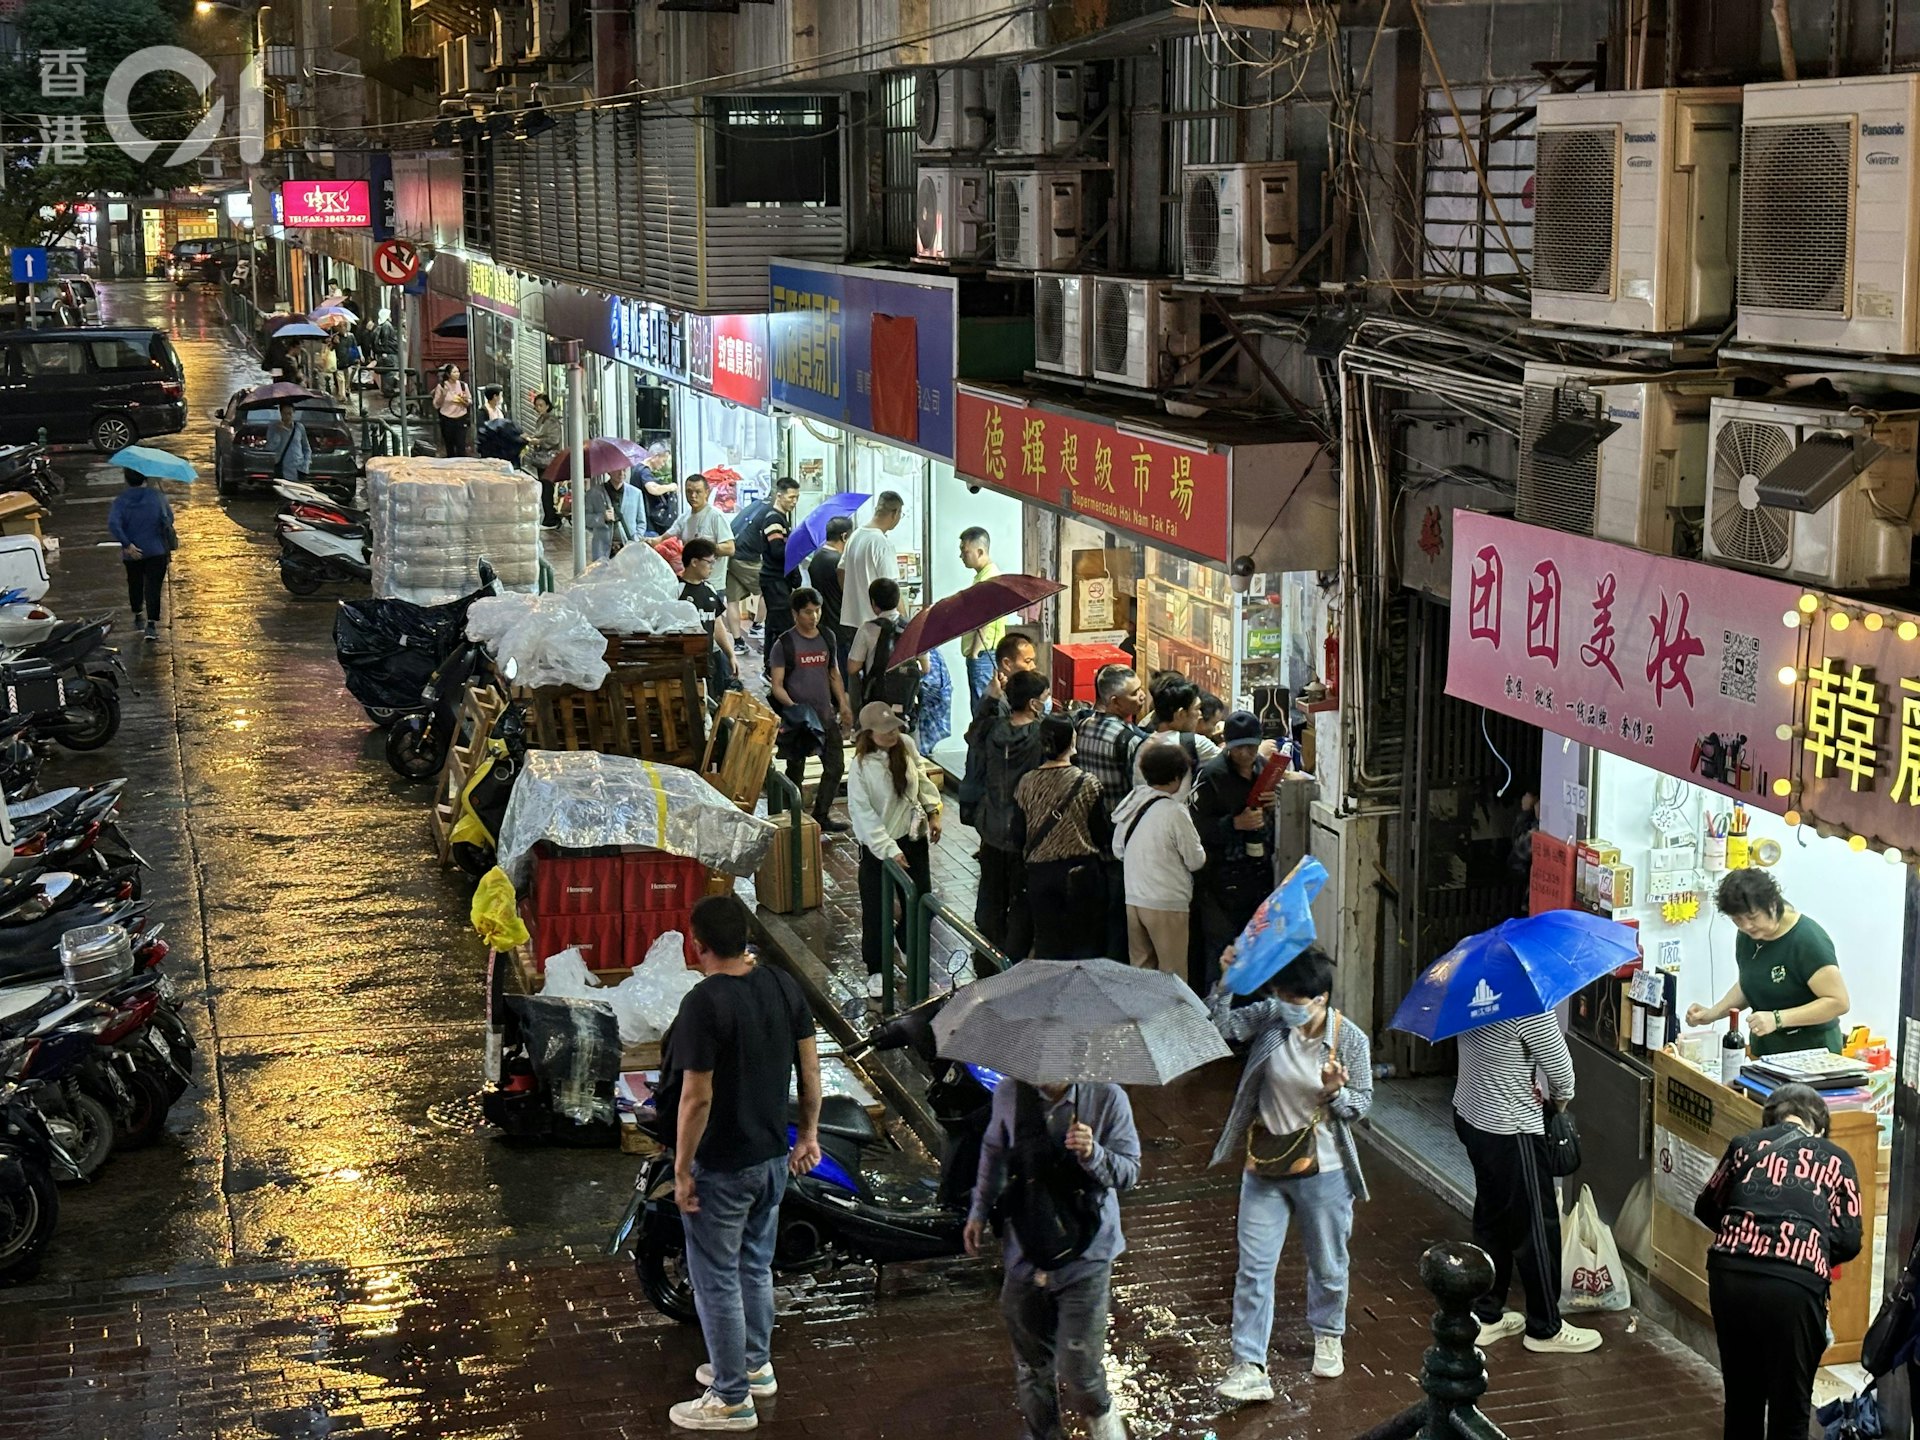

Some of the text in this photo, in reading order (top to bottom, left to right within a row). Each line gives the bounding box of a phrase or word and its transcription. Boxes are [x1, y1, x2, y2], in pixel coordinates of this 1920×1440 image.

[1624, 131, 1656, 143] Panasonic
[1861, 121, 1905, 137] Panasonic
[1608, 405, 1641, 420] Panasonic
[982, 405, 1195, 521] 德輝超級市場
[1072, 490, 1178, 537] Supermercado Hoi Nam Tak Fai
[1565, 785, 1586, 808] 35B
